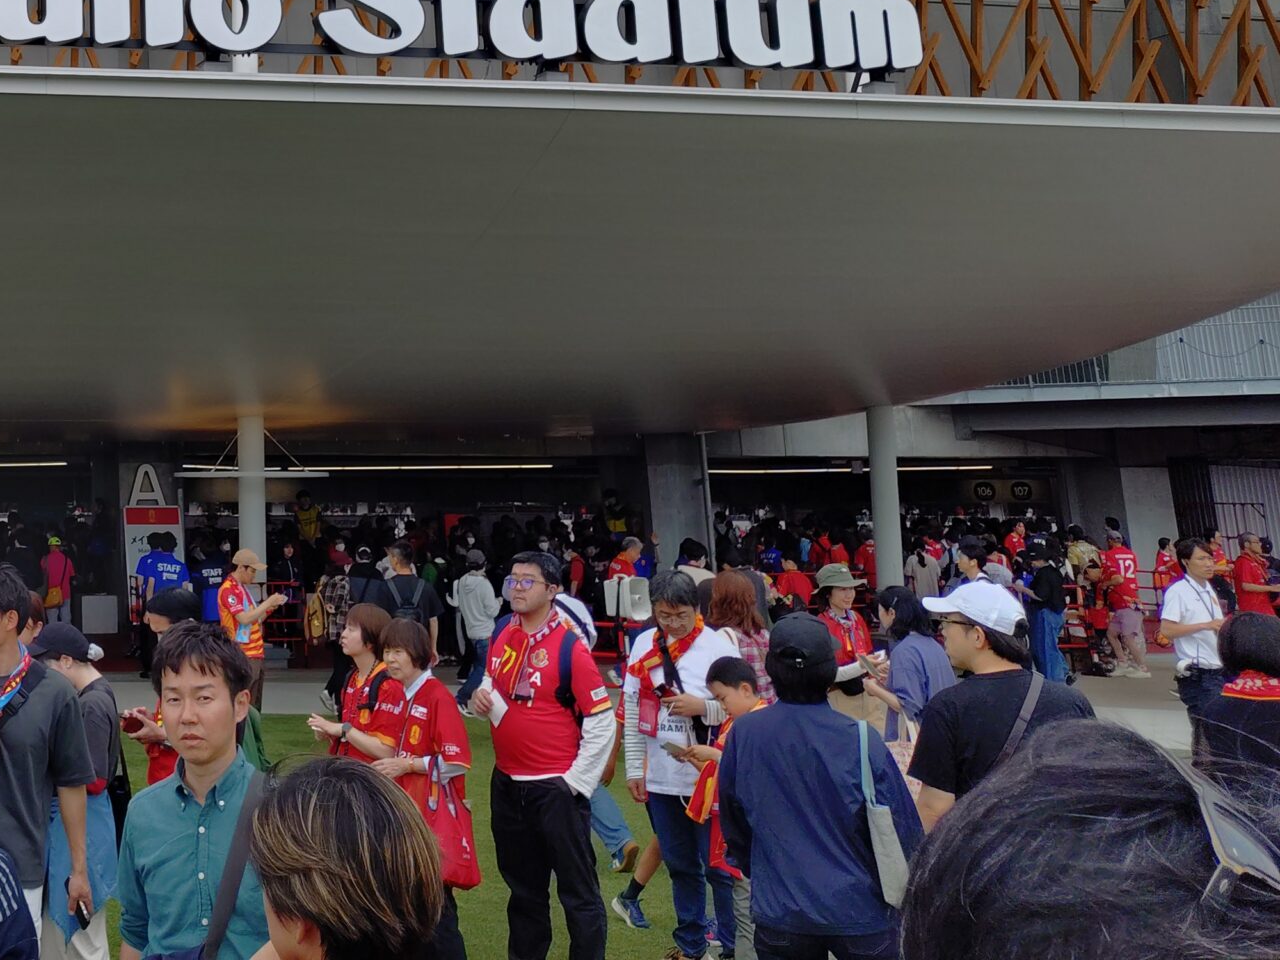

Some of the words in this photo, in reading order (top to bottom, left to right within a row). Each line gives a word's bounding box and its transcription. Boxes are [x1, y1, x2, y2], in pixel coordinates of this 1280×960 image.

[128, 464, 167, 507] A
[977, 487, 993, 497] 106
[1013, 487, 1029, 497] 107
[157, 562, 181, 573] STAFF
[202, 568, 223, 577] STAFF
[1118, 559, 1135, 578] 12
